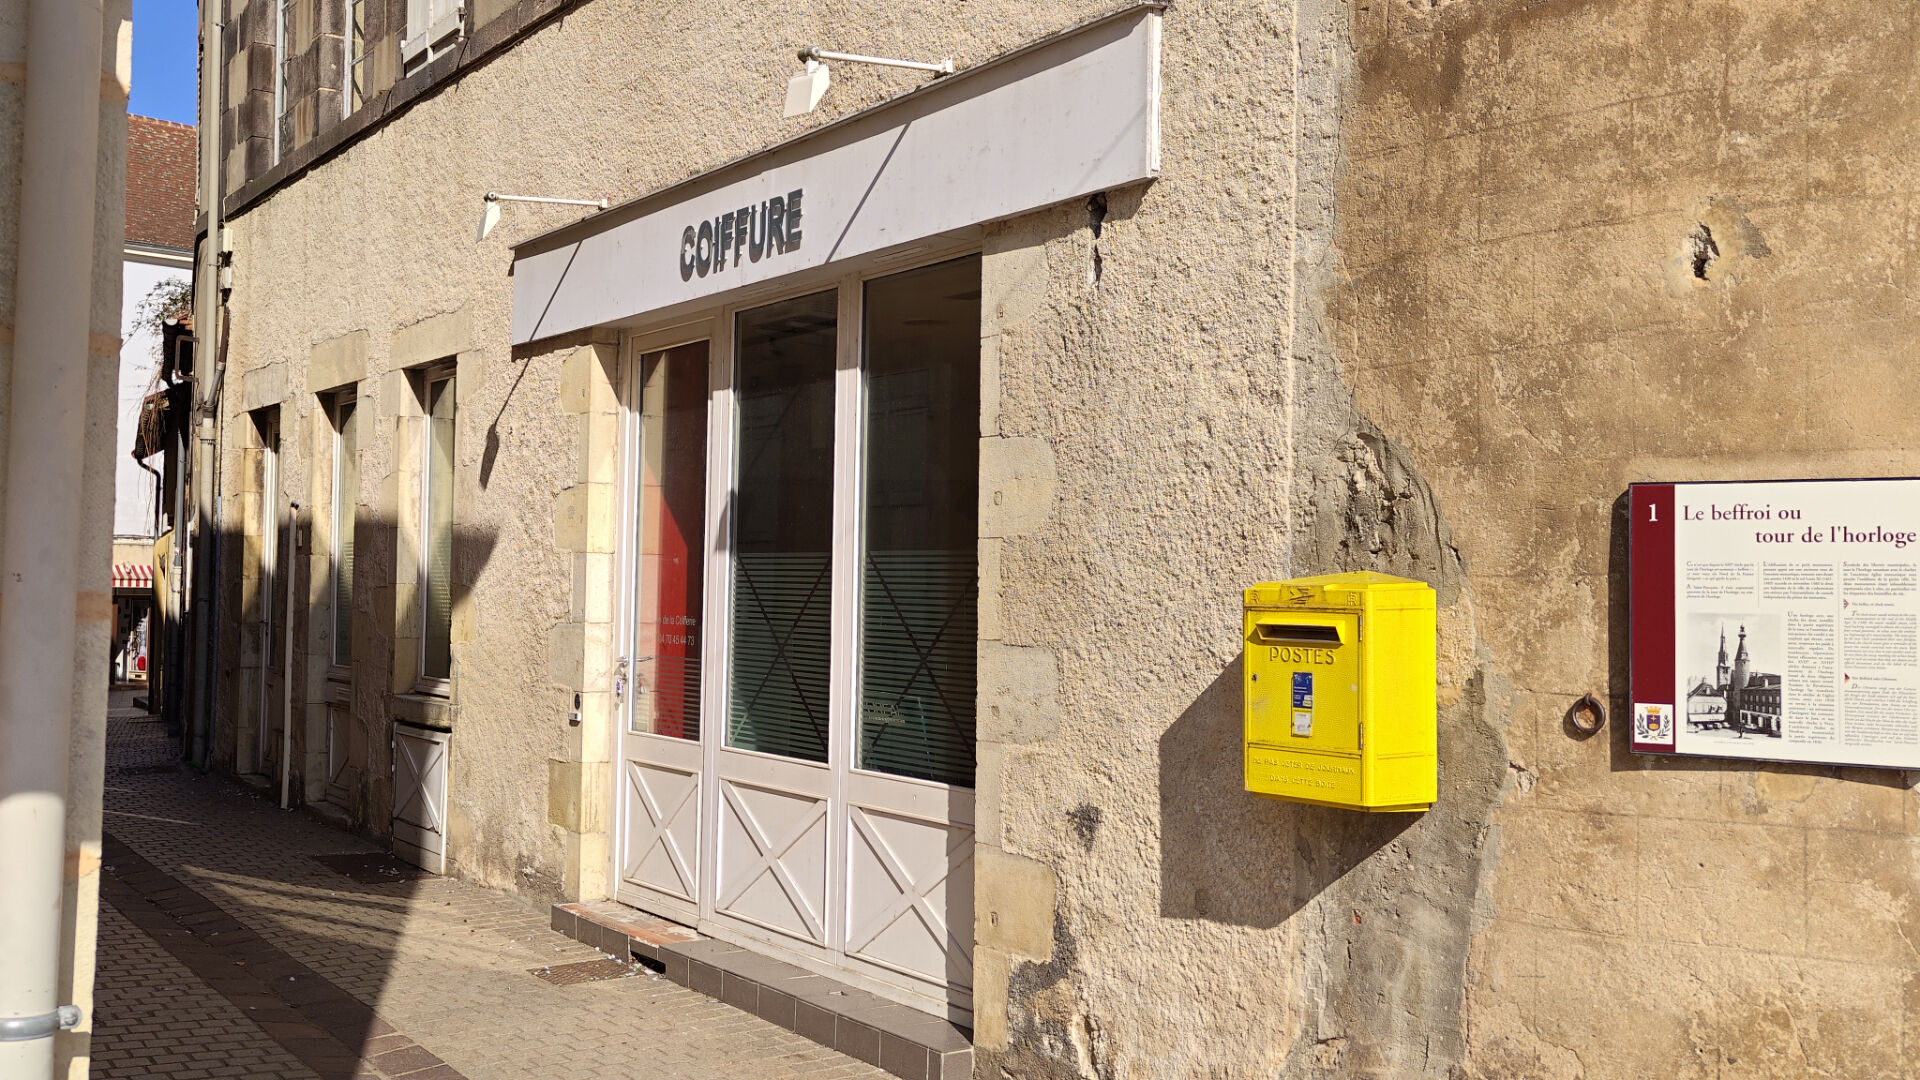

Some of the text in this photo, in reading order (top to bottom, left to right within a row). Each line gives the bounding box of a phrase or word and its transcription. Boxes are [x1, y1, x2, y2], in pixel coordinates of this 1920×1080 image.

[680, 188, 804, 282] COIFFURE
[1649, 503, 1658, 521] 1
[1683, 503, 1801, 520] Le beffroi ou
[1755, 525, 1917, 548] tour de l'horloge
[1269, 646, 1335, 666] POSTES
